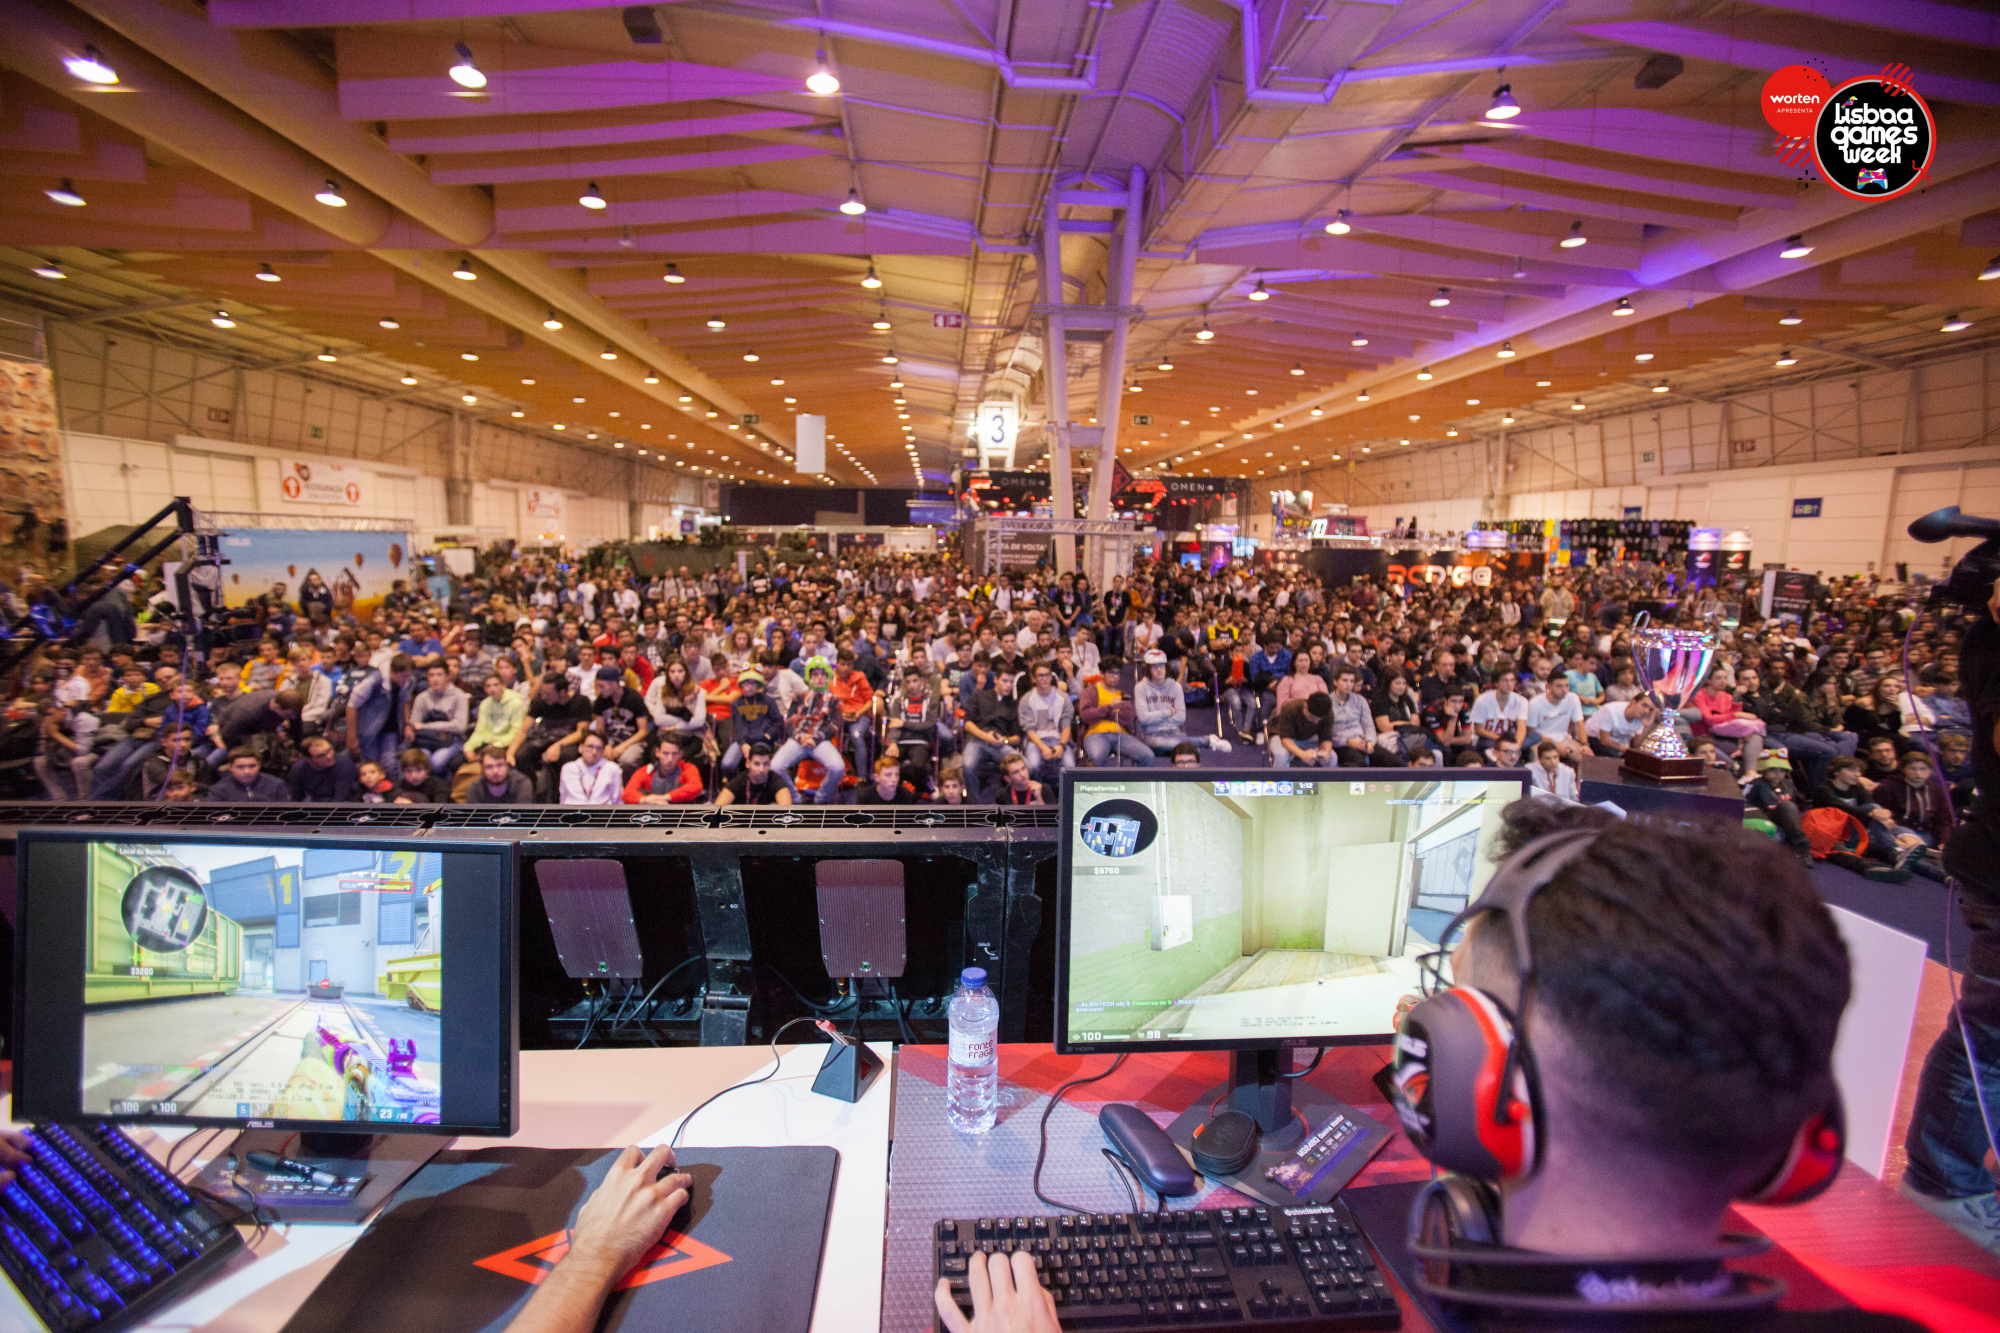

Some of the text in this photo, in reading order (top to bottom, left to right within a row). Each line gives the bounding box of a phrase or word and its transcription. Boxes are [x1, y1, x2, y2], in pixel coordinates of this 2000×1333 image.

[991, 415, 1005, 444] 3
[1002, 477, 1037, 487] OMEN
[1171, 482, 1204, 492] OMEN
[1094, 867, 1120, 876] $5750
[280, 873, 292, 905] 1
[1082, 1031, 1161, 1041] 100 98
[122, 1102, 177, 1113] 100 100
[240, 1105, 246, 1114] 5
[380, 1109, 392, 1119] 23
